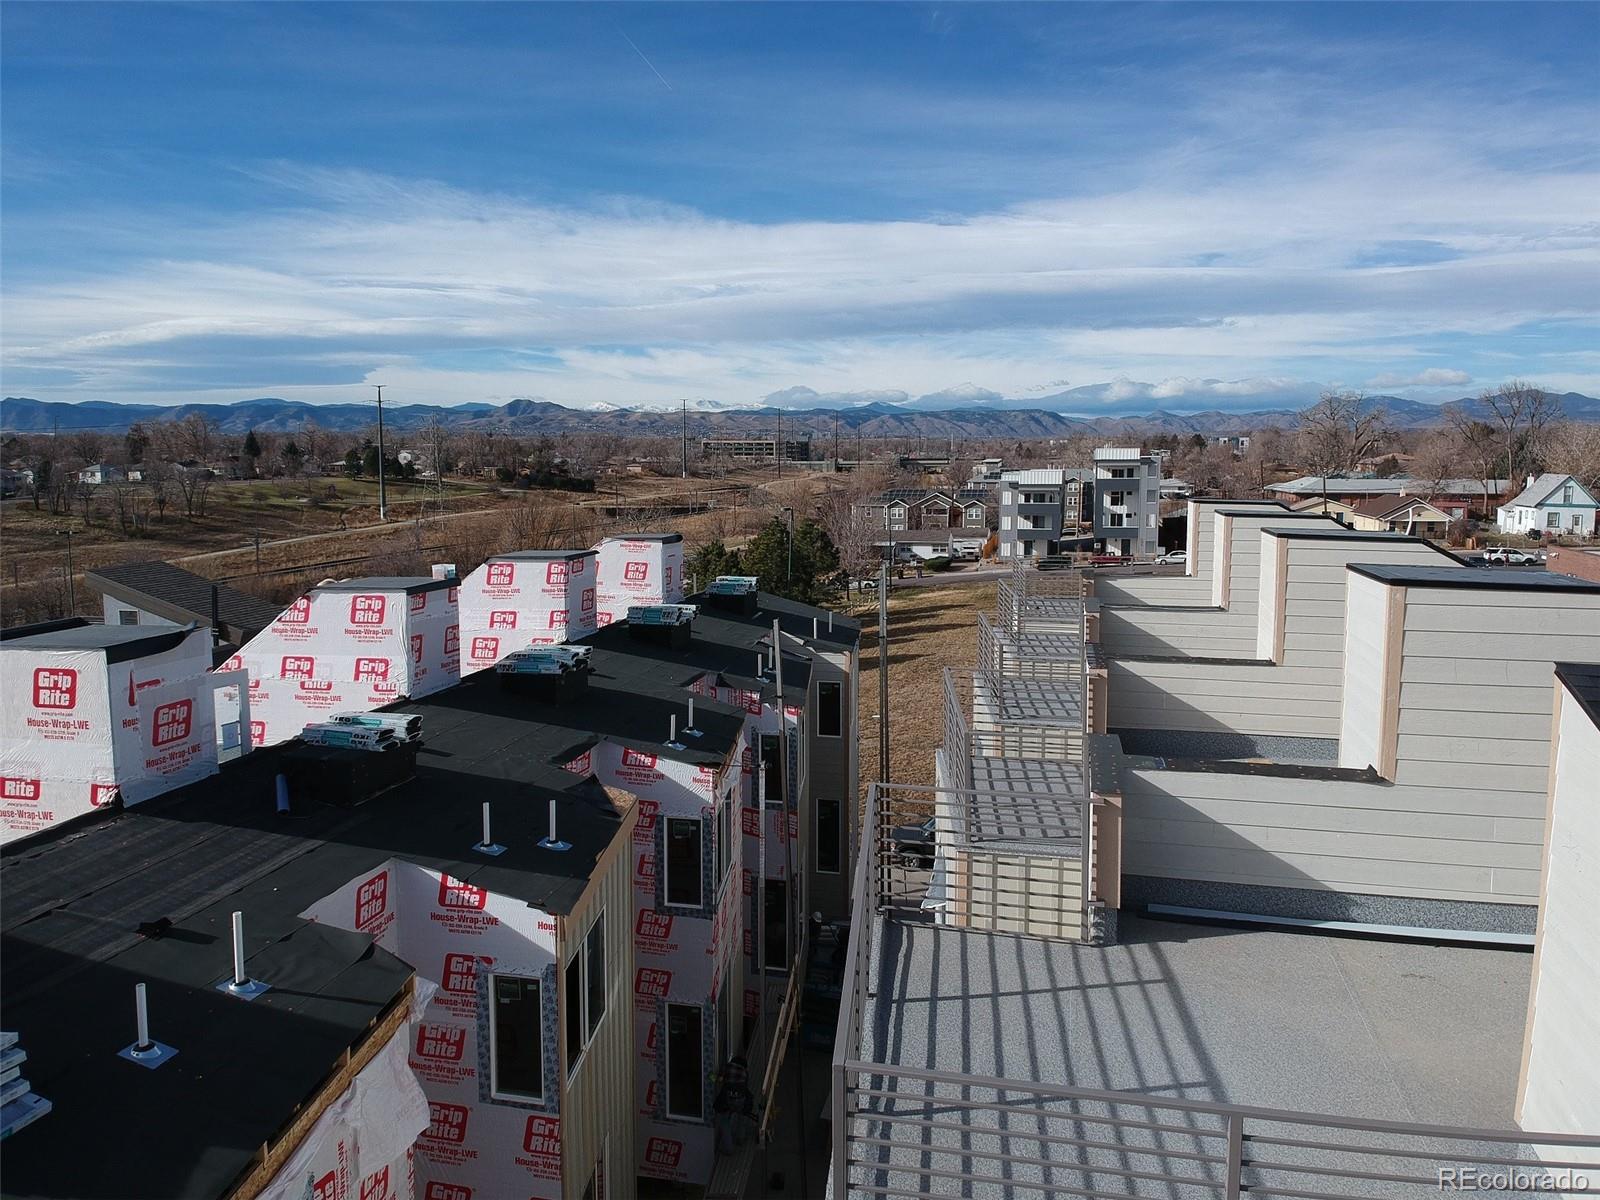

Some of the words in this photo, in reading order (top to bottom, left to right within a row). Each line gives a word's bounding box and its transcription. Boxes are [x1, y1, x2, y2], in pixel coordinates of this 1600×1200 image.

[491, 565, 511, 576] Grip
[629, 563, 646, 573] Grip
[490, 575, 510, 584] Rite
[356, 597, 382, 611] Grip
[355, 611, 380, 623] Rite
[493, 613, 514, 623] Grip
[475, 639, 496, 650] Grip
[474, 648, 494, 658] Rite
[285, 658, 311, 672] Grip
[359, 660, 386, 673] Grip
[38, 671, 72, 691] Grip
[38, 689, 70, 706] Rite
[158, 704, 188, 725] Grip
[27, 717, 90, 730] House-Wrap-LWE
[157, 722, 185, 743] Rite
[145, 743, 201, 768] House-Wrap-LWE
[4, 780, 35, 797] Rite
[0, 809, 54, 820] ouse-Wrap-LWE
[360, 878, 384, 905] Grip
[445, 889, 480, 907] Rite
[360, 898, 382, 924] Rite
[430, 911, 499, 926] House-Wrap-LWE
[450, 956, 476, 974] Gri
[448, 974, 475, 990] Rit
[641, 970, 668, 984] Grip
[425, 1025, 461, 1041] Grip
[423, 1039, 457, 1058] Rite
[409, 1060, 476, 1078] House-Wrap-LWE
[429, 1105, 463, 1124] Grip
[425, 1121, 460, 1140] Rite
[532, 1119, 560, 1136] Gri
